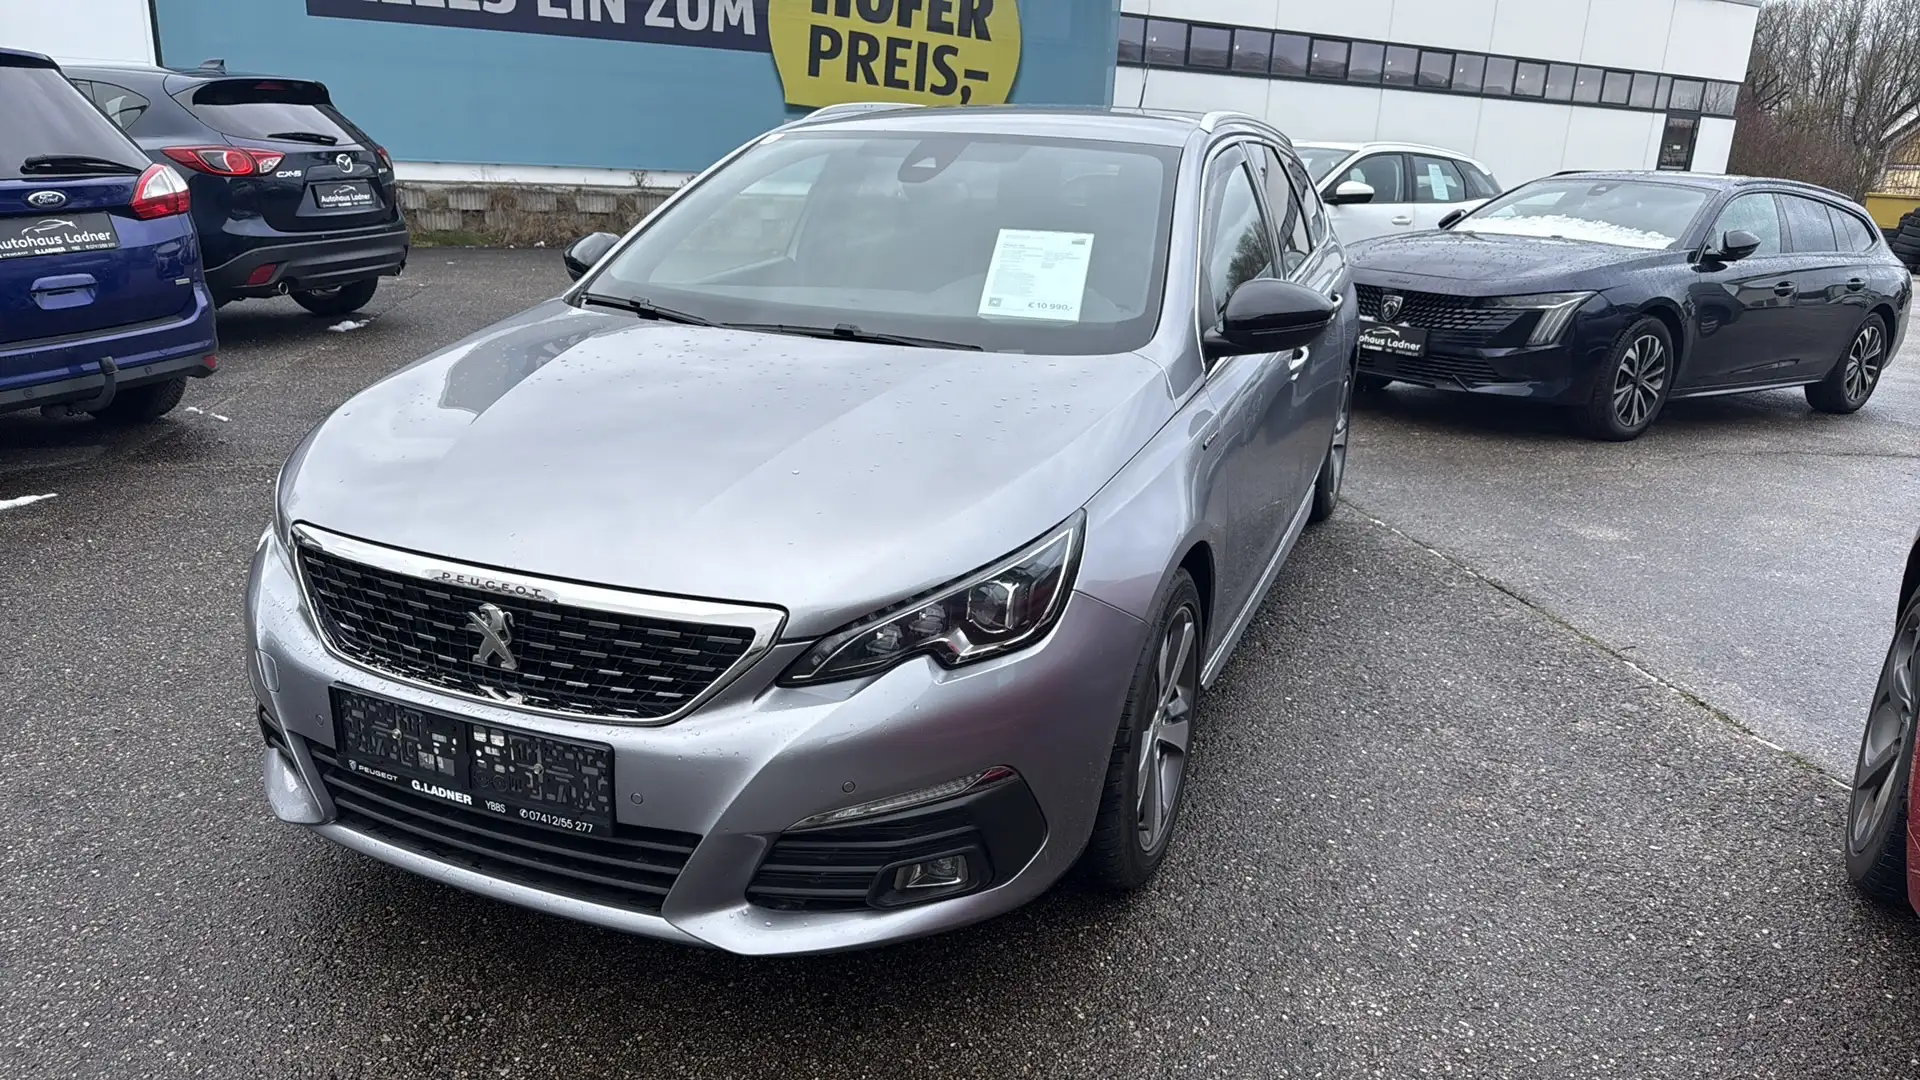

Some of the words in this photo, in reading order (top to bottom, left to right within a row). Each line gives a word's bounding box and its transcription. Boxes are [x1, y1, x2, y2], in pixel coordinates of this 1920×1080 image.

[64, 231, 111, 244] Ladner
[1358, 335, 1385, 346] ohaus
[1387, 338, 1421, 351] Ladner
[442, 572, 541, 597] PEUGEOT
[358, 764, 398, 782] PEUGEOT
[411, 780, 473, 805] G.LADNER
[575, 821, 593, 833] 277
